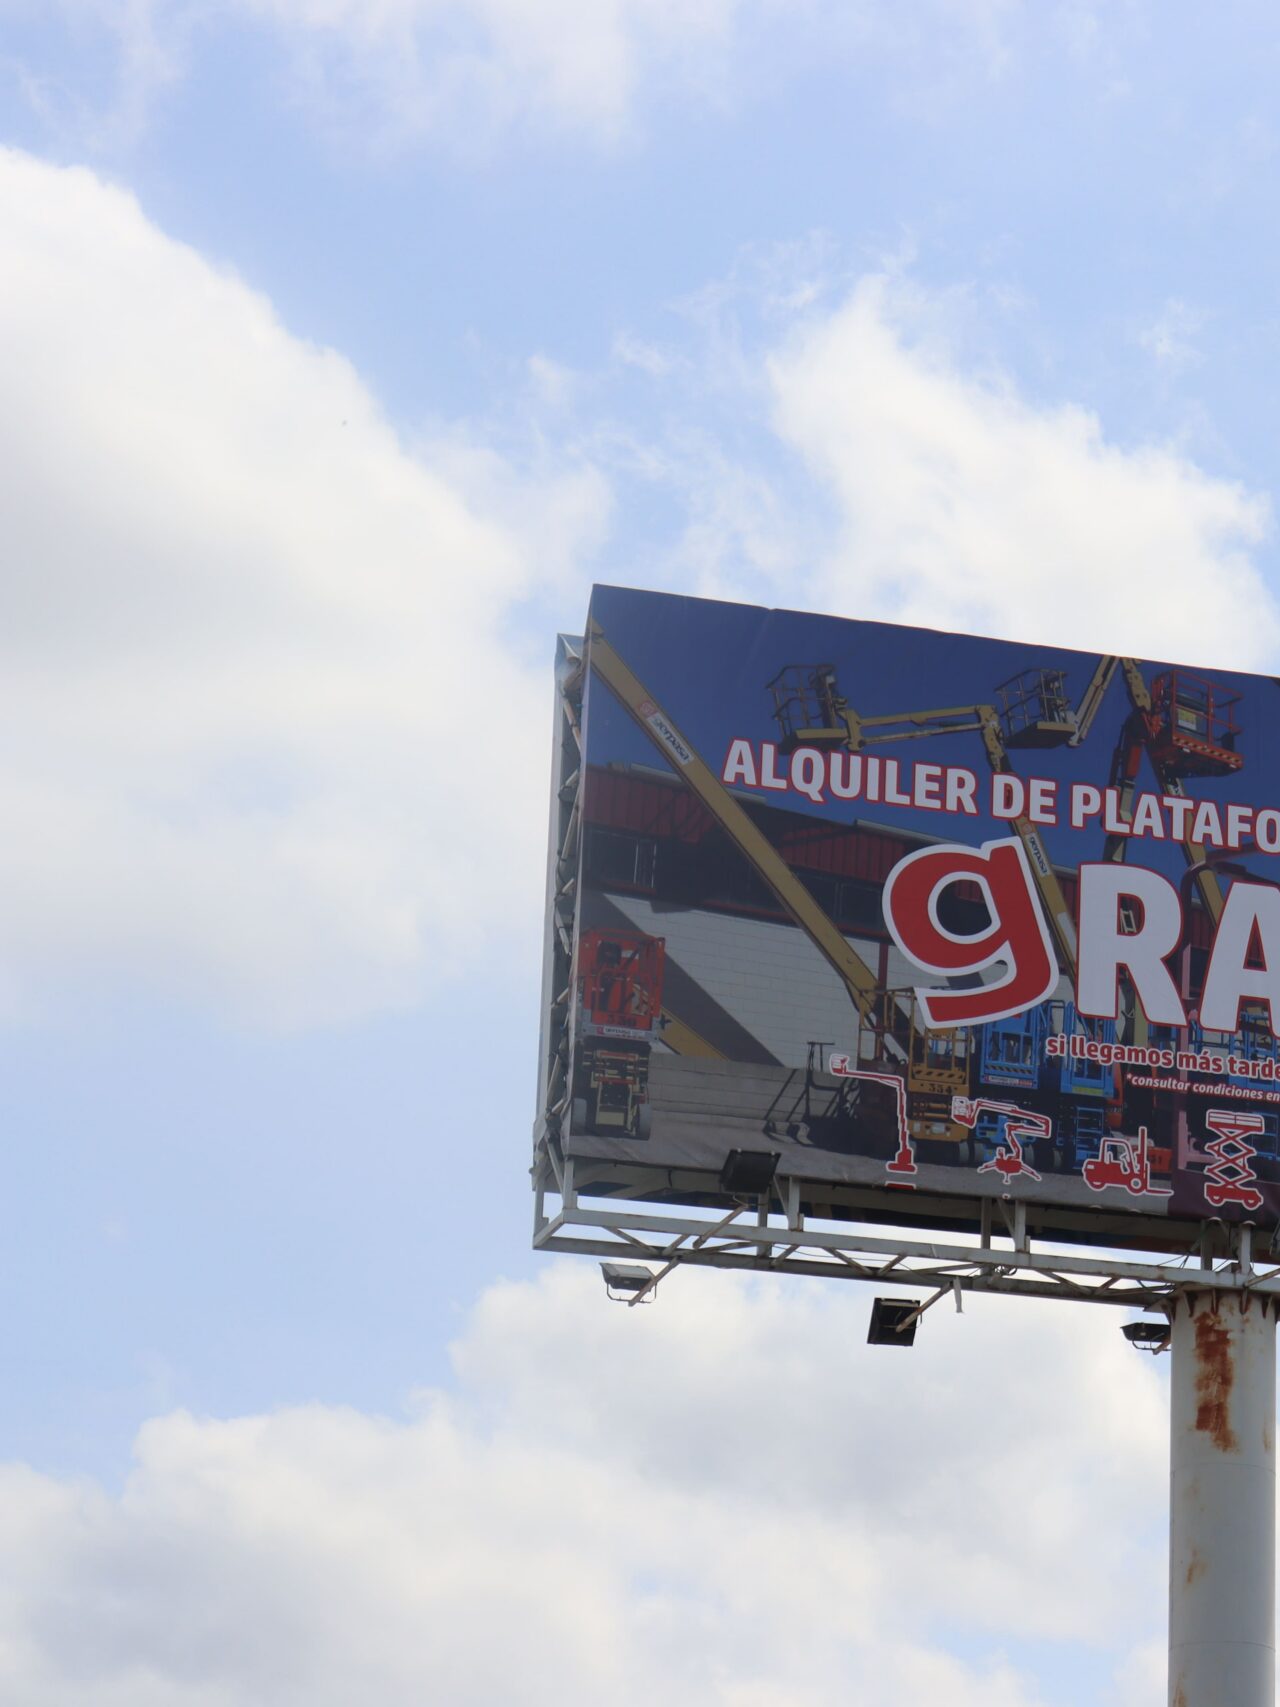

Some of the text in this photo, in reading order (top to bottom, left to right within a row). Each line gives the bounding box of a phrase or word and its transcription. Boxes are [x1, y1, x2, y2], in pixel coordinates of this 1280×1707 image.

[722, 738, 979, 816] ALQUILER
[992, 773, 1057, 825] DE
[1045, 1033, 1067, 1056] si
[1070, 1035, 1174, 1067] llegamos
[1176, 1051, 1223, 1074] más
[1192, 1081, 1263, 1100] condiciones
[1266, 1091, 1280, 1102] en
